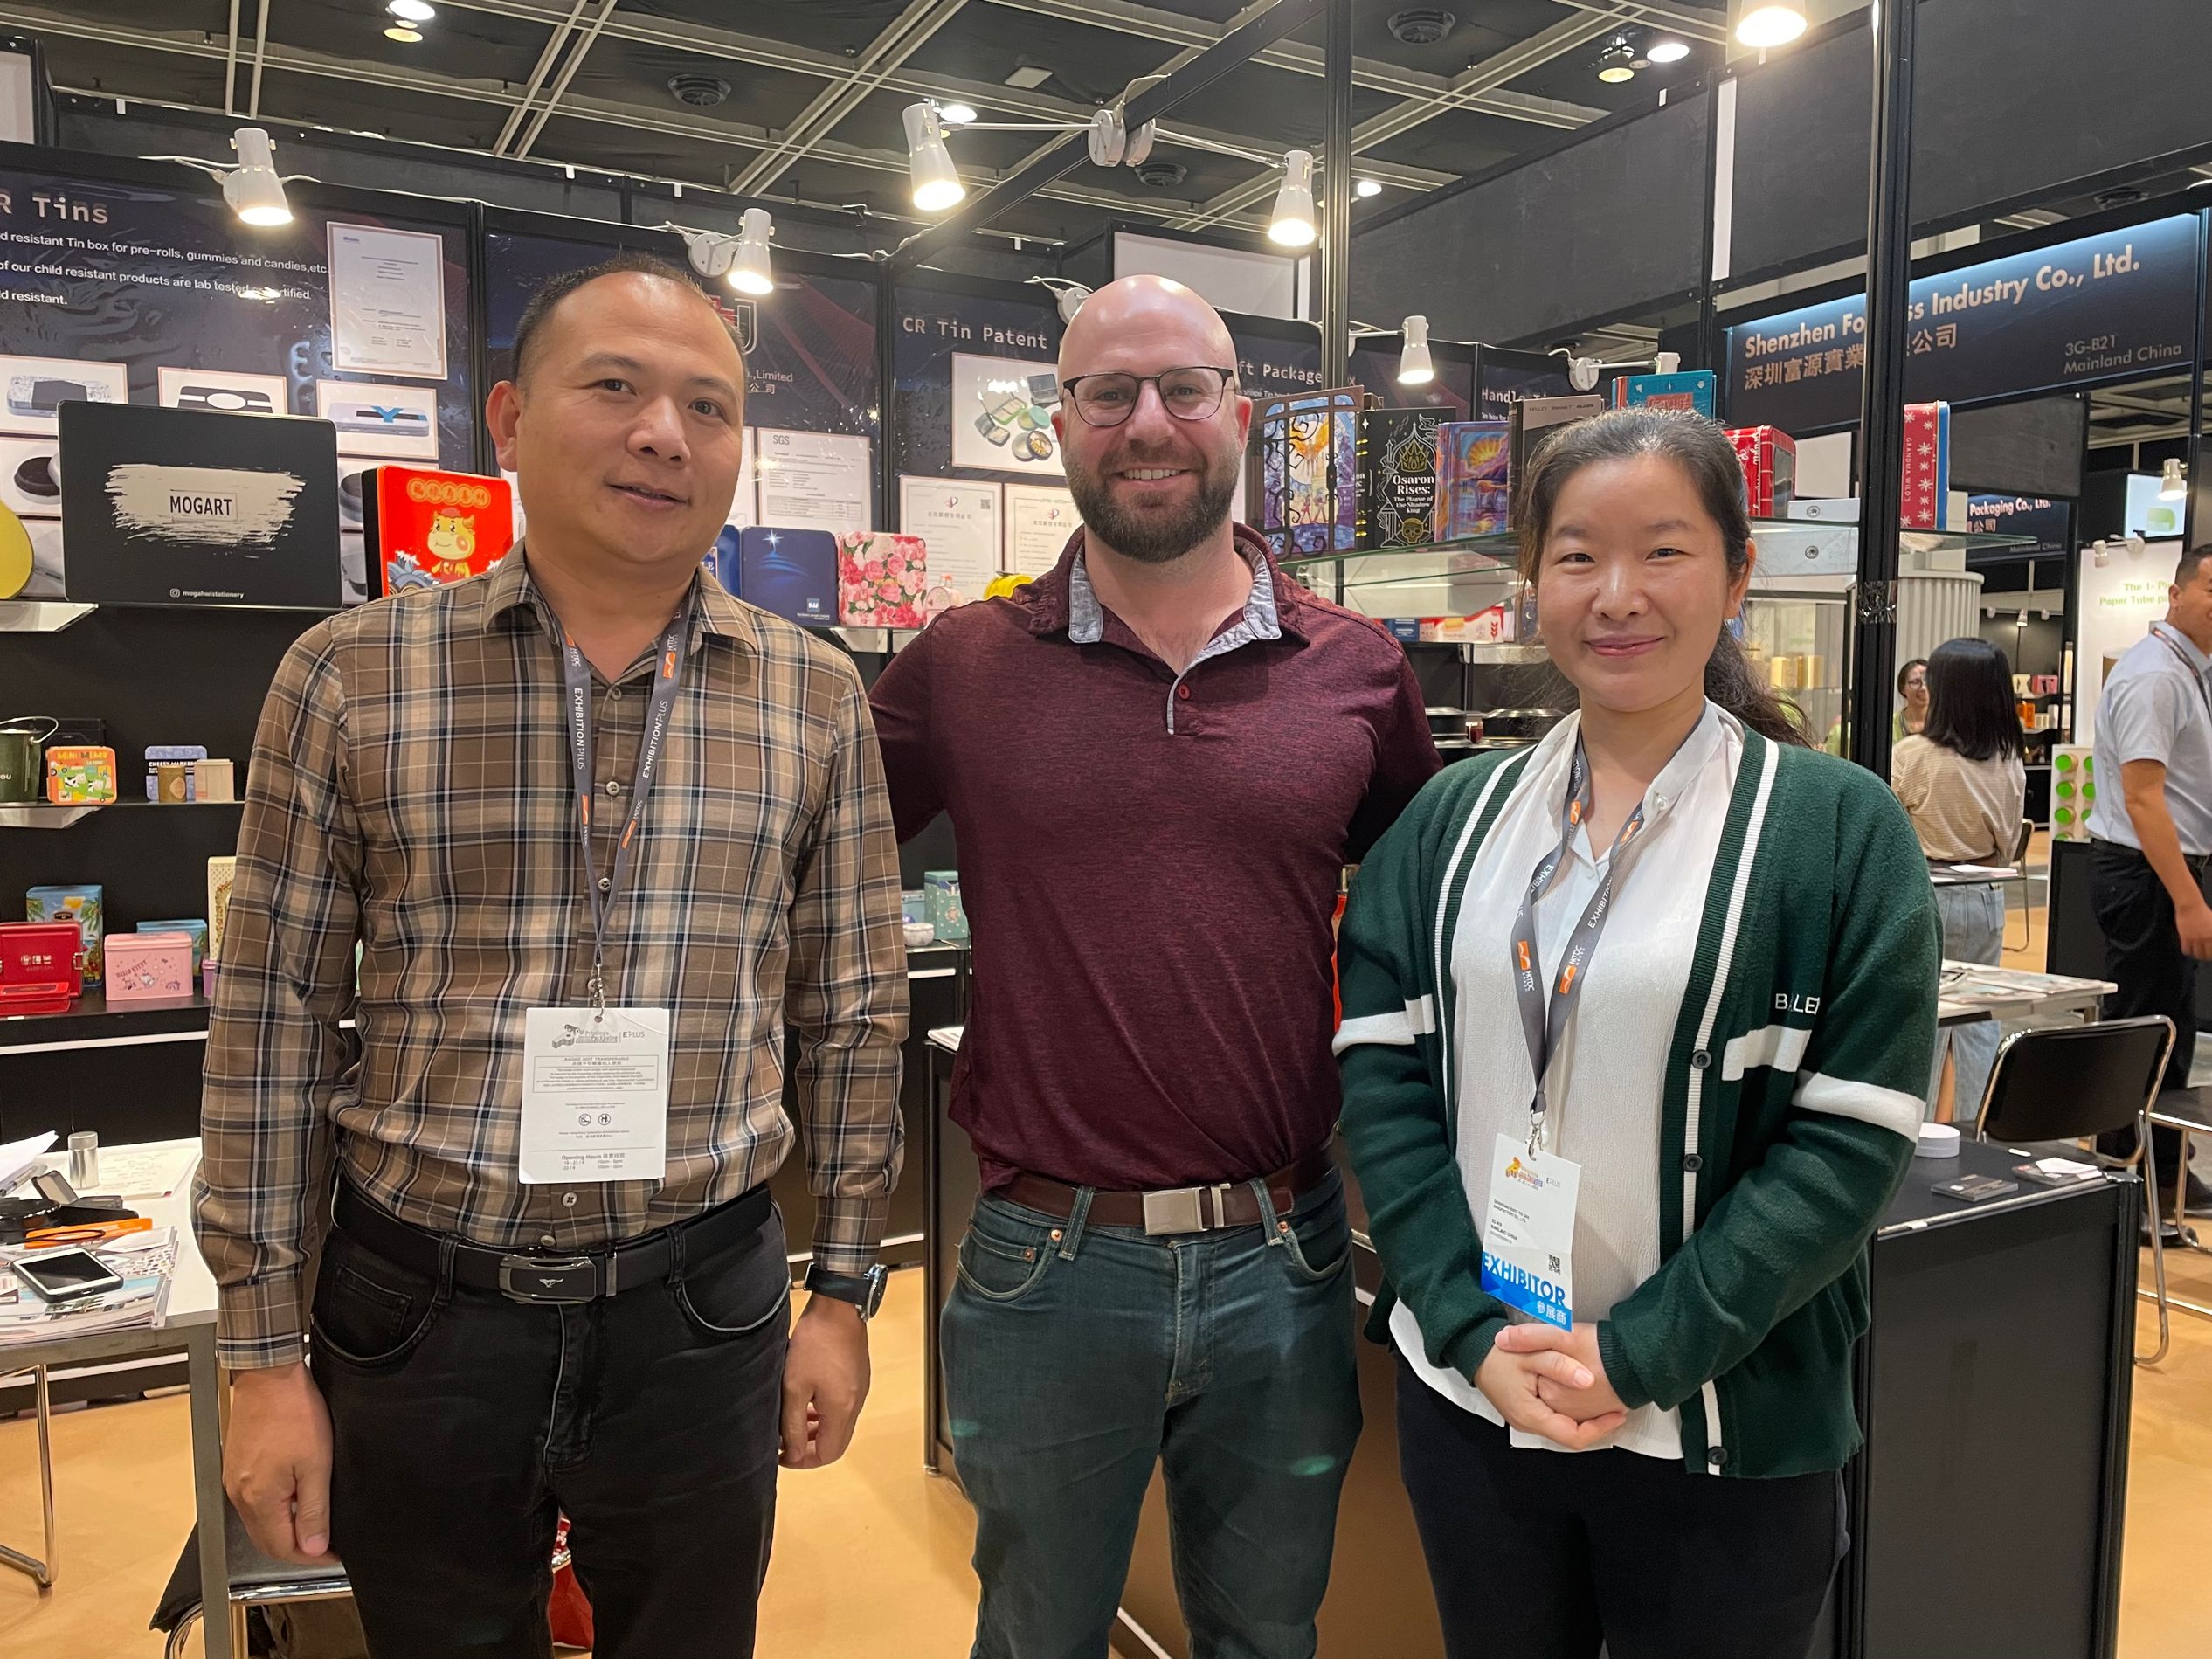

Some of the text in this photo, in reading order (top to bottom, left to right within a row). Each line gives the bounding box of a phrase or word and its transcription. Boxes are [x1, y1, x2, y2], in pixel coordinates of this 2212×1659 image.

[32, 196, 108, 224] Tins
[10, 233, 64, 247] resistant
[66, 237, 86, 249] Tin
[86, 239, 109, 251] box
[111, 241, 128, 252] for
[130, 245, 184, 260] pre-rolls,
[186, 251, 238, 265] gummies
[240, 256, 262, 267] and
[11, 264, 32, 273] our
[34, 264, 63, 276] child
[65, 266, 117, 281] resistant
[119, 273, 170, 286] products
[172, 278, 192, 288] are
[194, 279, 211, 290] lab
[11, 292, 68, 305] resistant.
[1745, 321, 1835, 359] Shenzhen
[1932, 277, 2029, 316] Industry
[2036, 265, 2084, 292] Co.,
[2093, 244, 2140, 280] Ltd.
[902, 316, 1047, 349] CR Tin Patent
[2064, 334, 2117, 356] 3G-B21
[2063, 343, 2183, 375] Mainland China
[772, 434, 790, 446] SGS
[1392, 474, 1435, 486] Osaron
[1397, 485, 1431, 495] Rises:
[169, 495, 232, 516] MOGART
[1969, 498, 2015, 517] Packaging
[1483, 1251, 1566, 1308] EXHIBITOR
